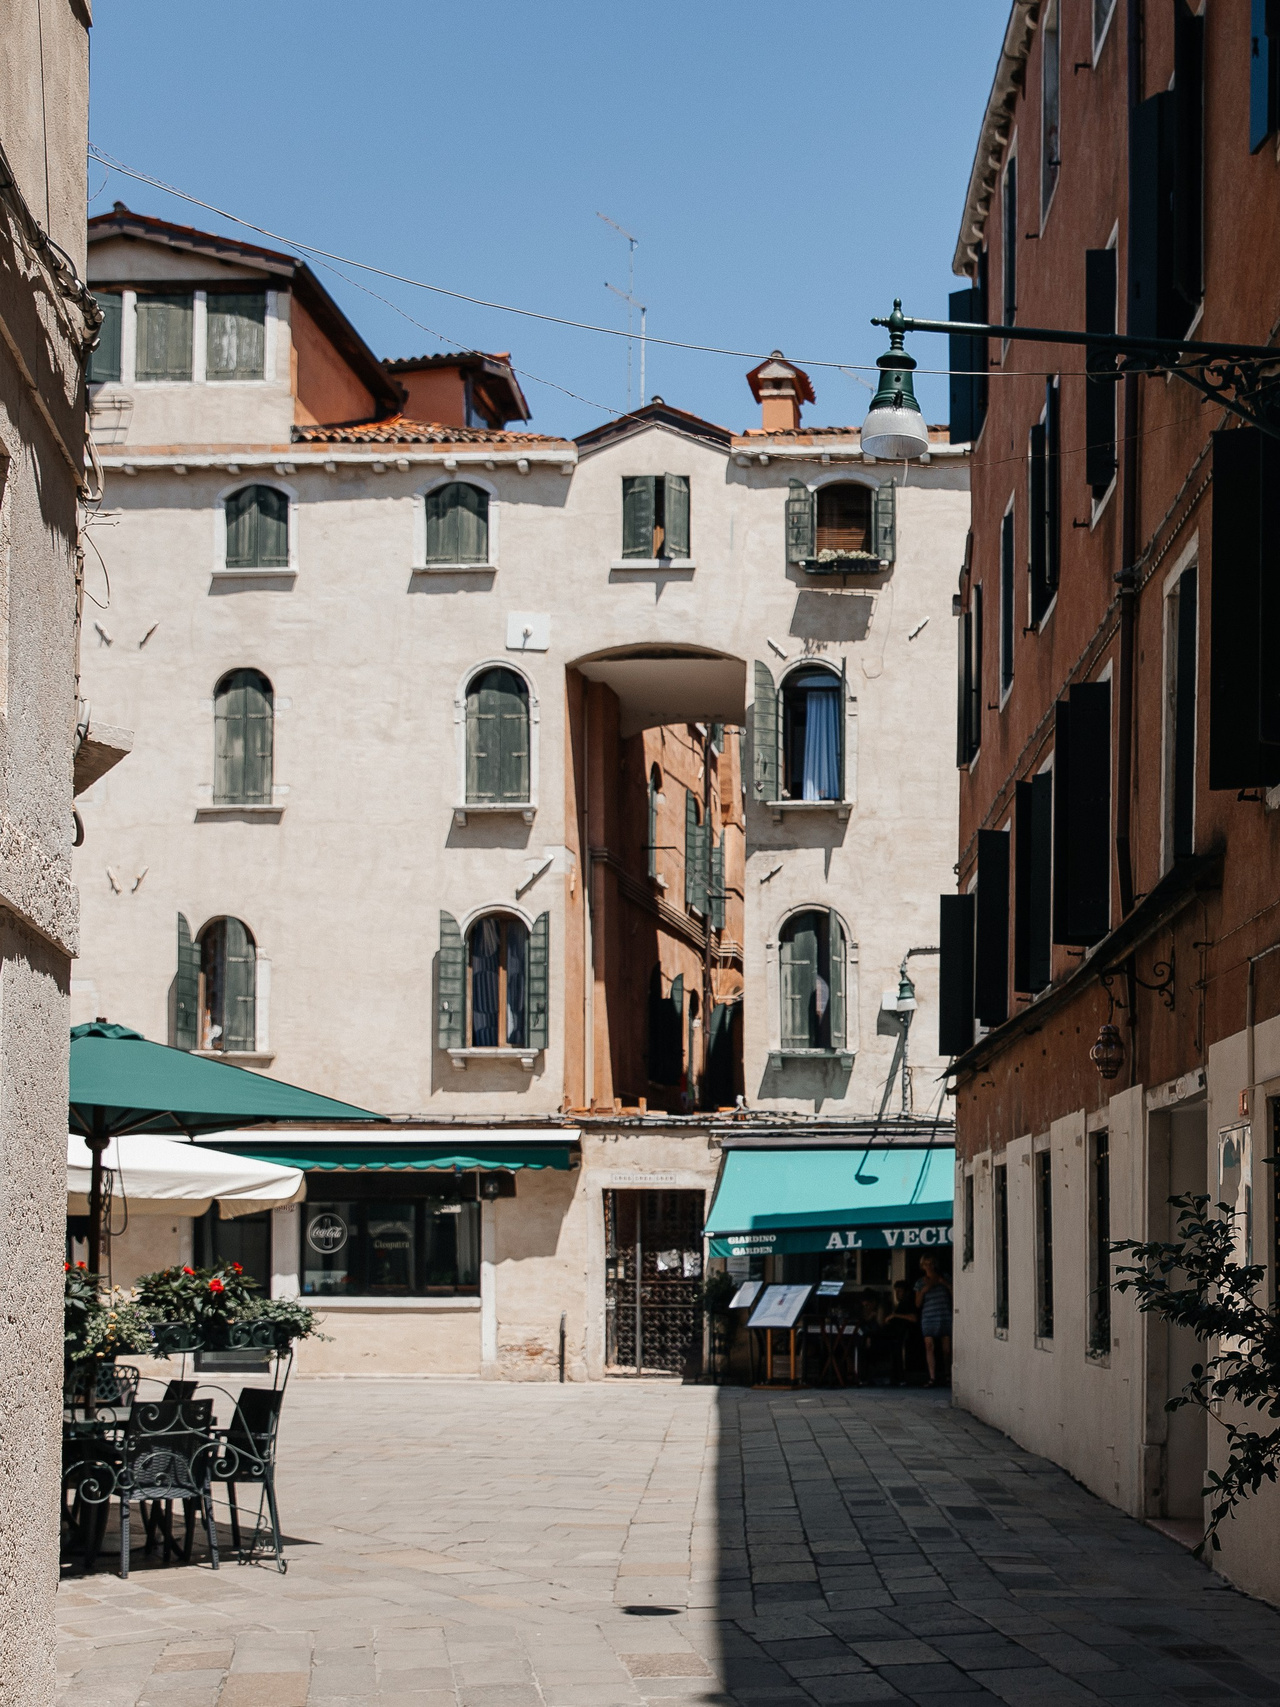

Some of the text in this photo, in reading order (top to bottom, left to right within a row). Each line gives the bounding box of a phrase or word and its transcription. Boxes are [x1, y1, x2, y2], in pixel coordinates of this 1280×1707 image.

[727, 1234, 777, 1245] GIARDINO
[825, 1231, 862, 1250] AL
[732, 1246, 773, 1256] GARDEN
